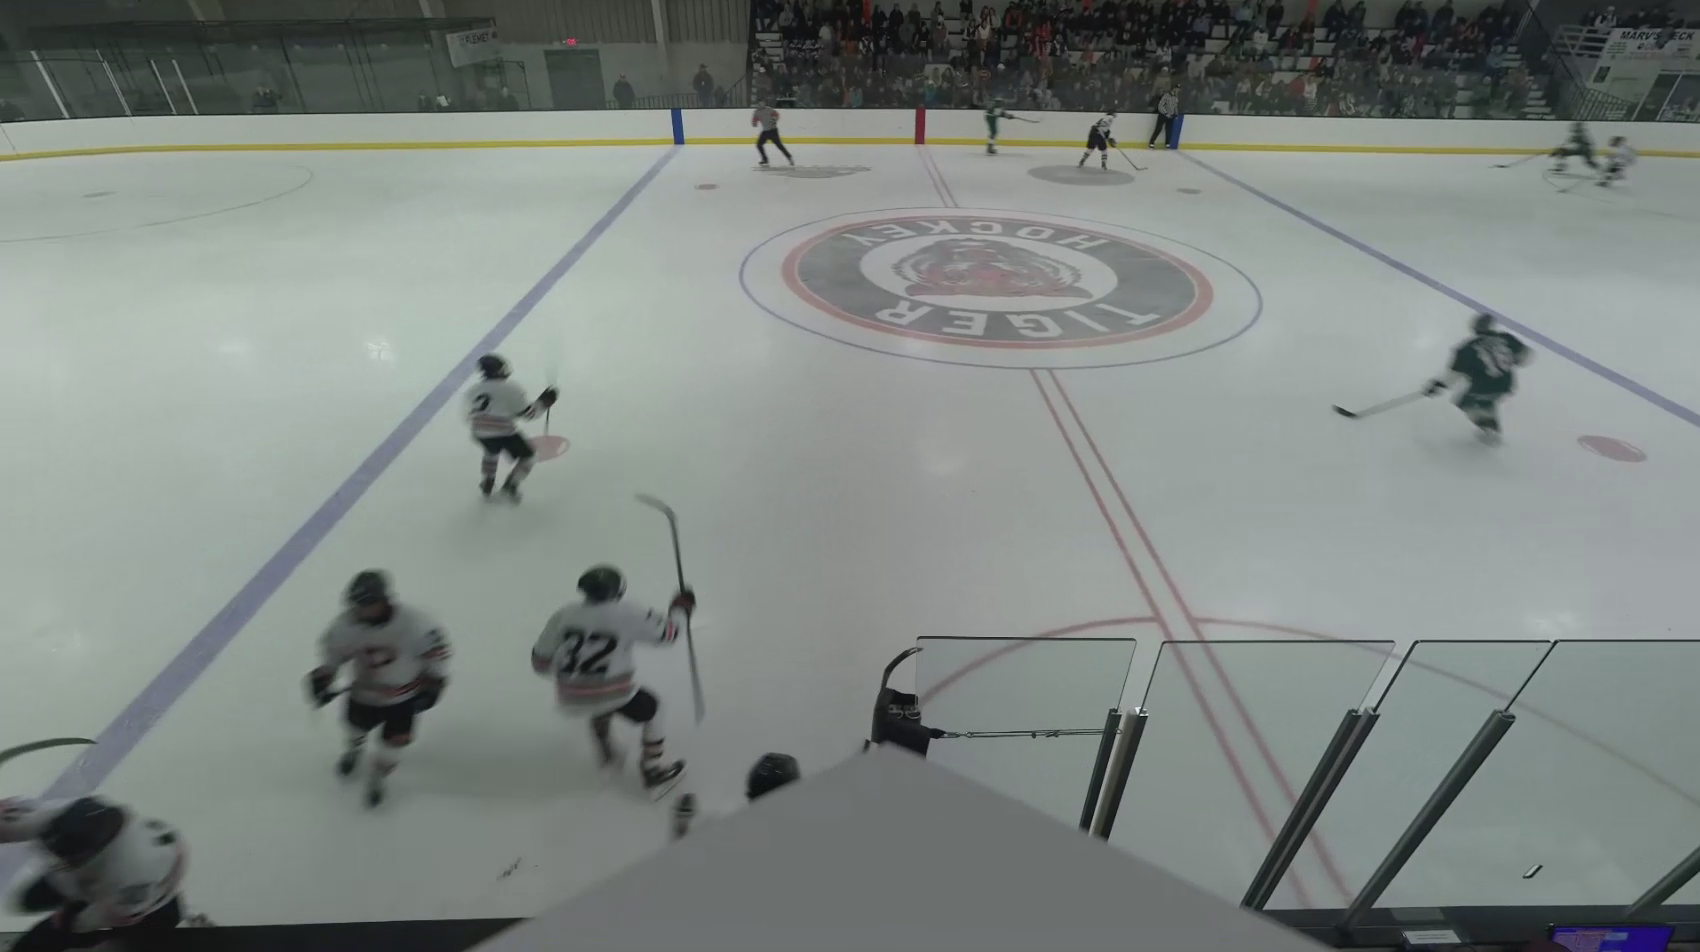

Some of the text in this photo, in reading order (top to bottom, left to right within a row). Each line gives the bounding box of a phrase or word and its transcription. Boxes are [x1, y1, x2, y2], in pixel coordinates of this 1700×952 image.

[1620, 31, 1662, 40] MARV'S
[841, 220, 1109, 249] HOCKEY
[875, 300, 1161, 337] TIGER
[559, 627, 620, 675] 32
